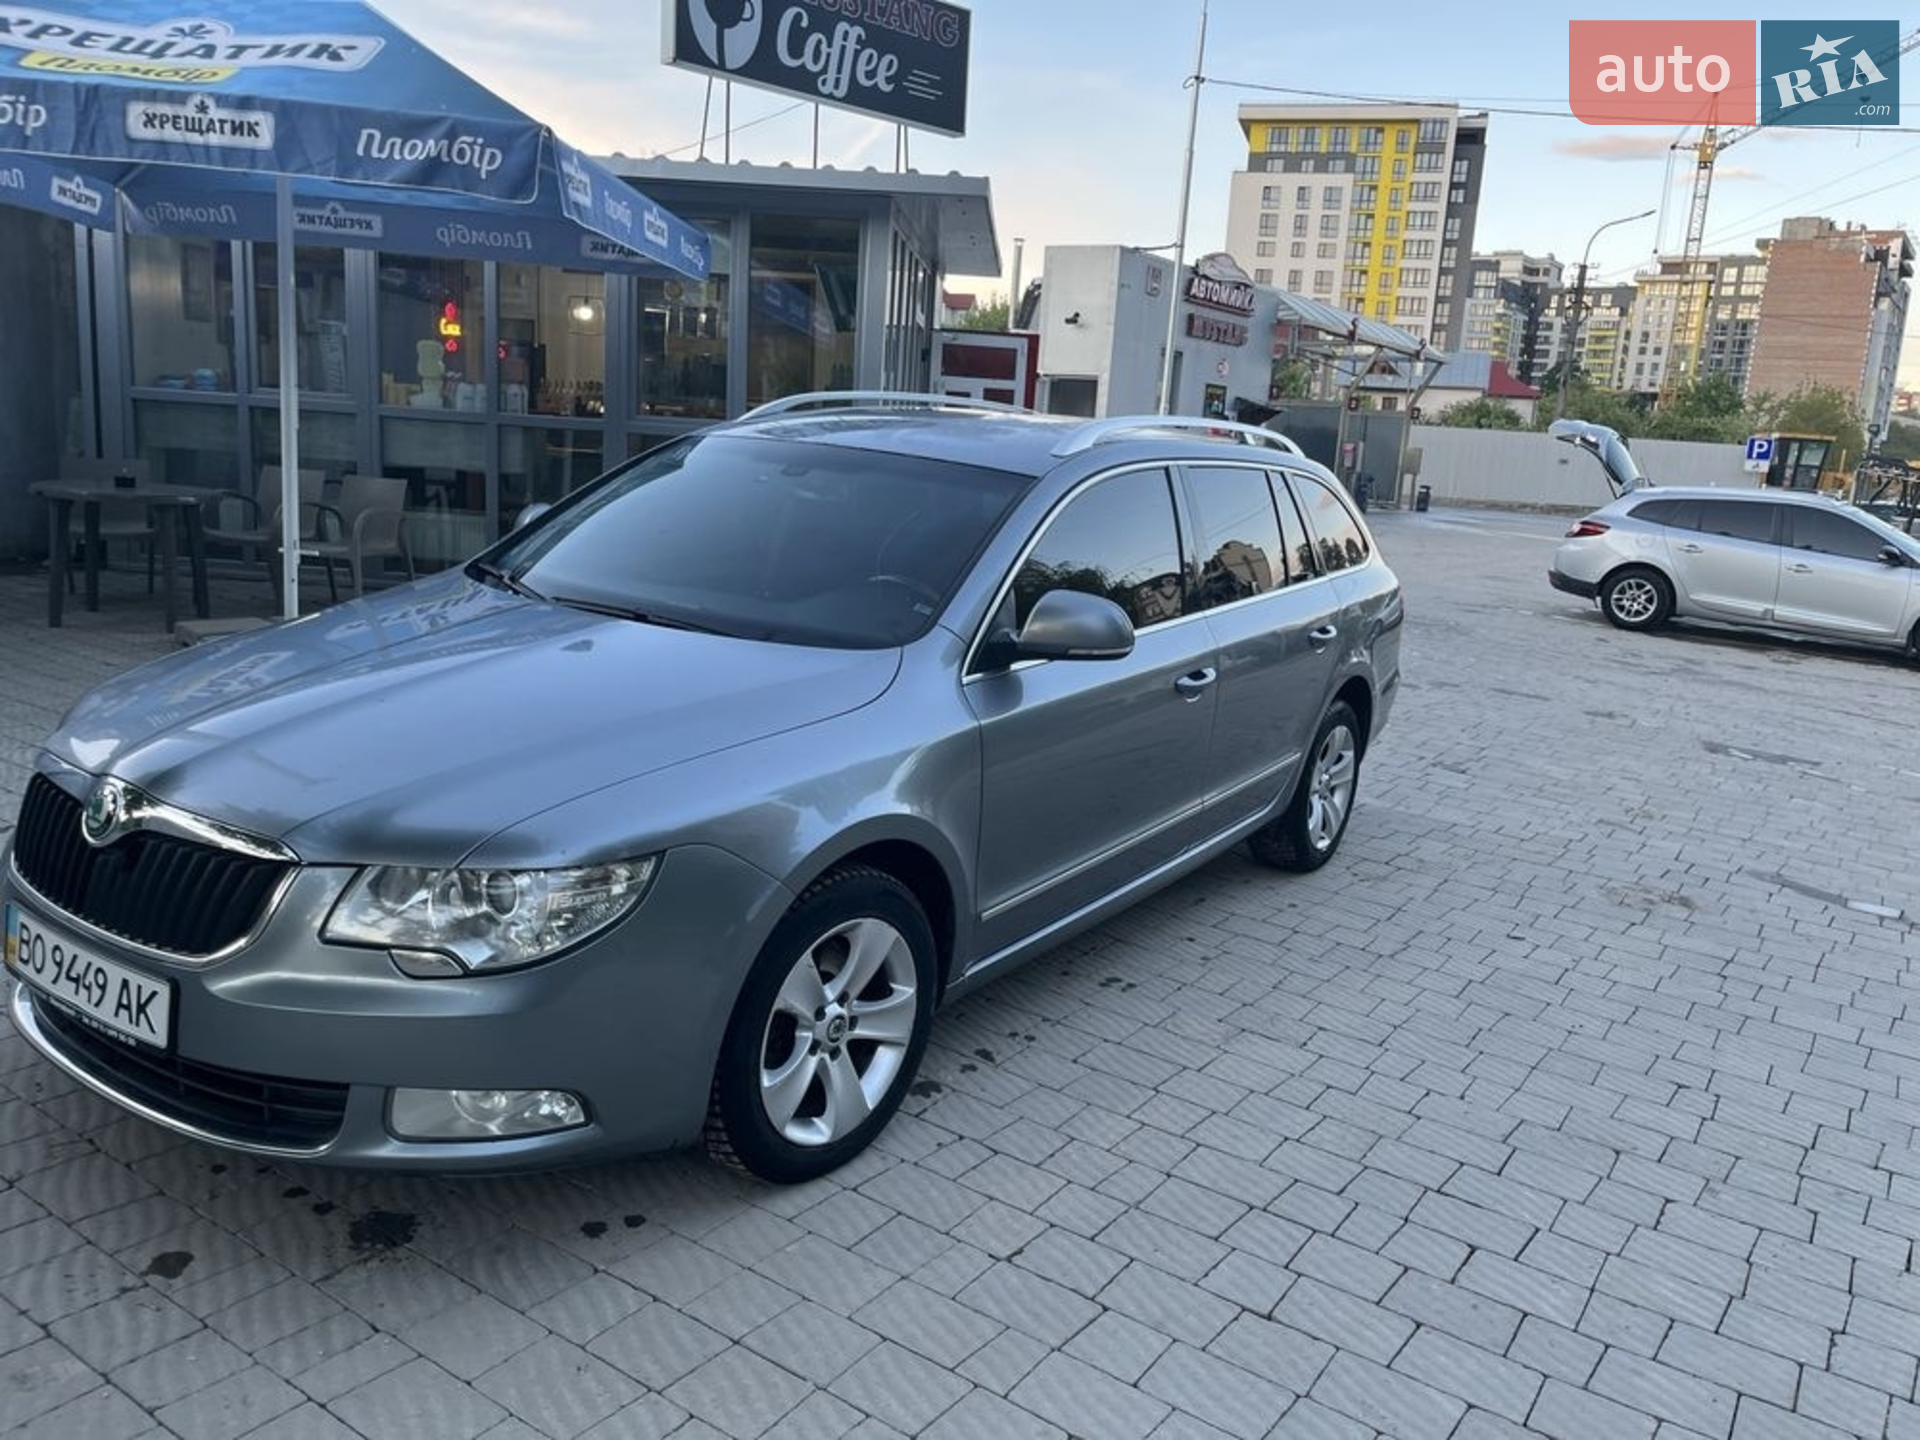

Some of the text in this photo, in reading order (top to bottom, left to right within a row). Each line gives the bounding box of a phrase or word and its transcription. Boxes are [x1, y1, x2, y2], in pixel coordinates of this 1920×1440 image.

[803, 0, 960, 48] TANG
[37, 55, 220, 82] Пломбір
[776, 6, 899, 98] Coffee
[142, 110, 260, 139] ХРЕЩАТИК
[356, 127, 503, 180] Пломбір
[1751, 440, 1769, 459] P
[18, 921, 46, 975] BO
[51, 944, 108, 1009] 9449
[114, 978, 159, 1035] AK
